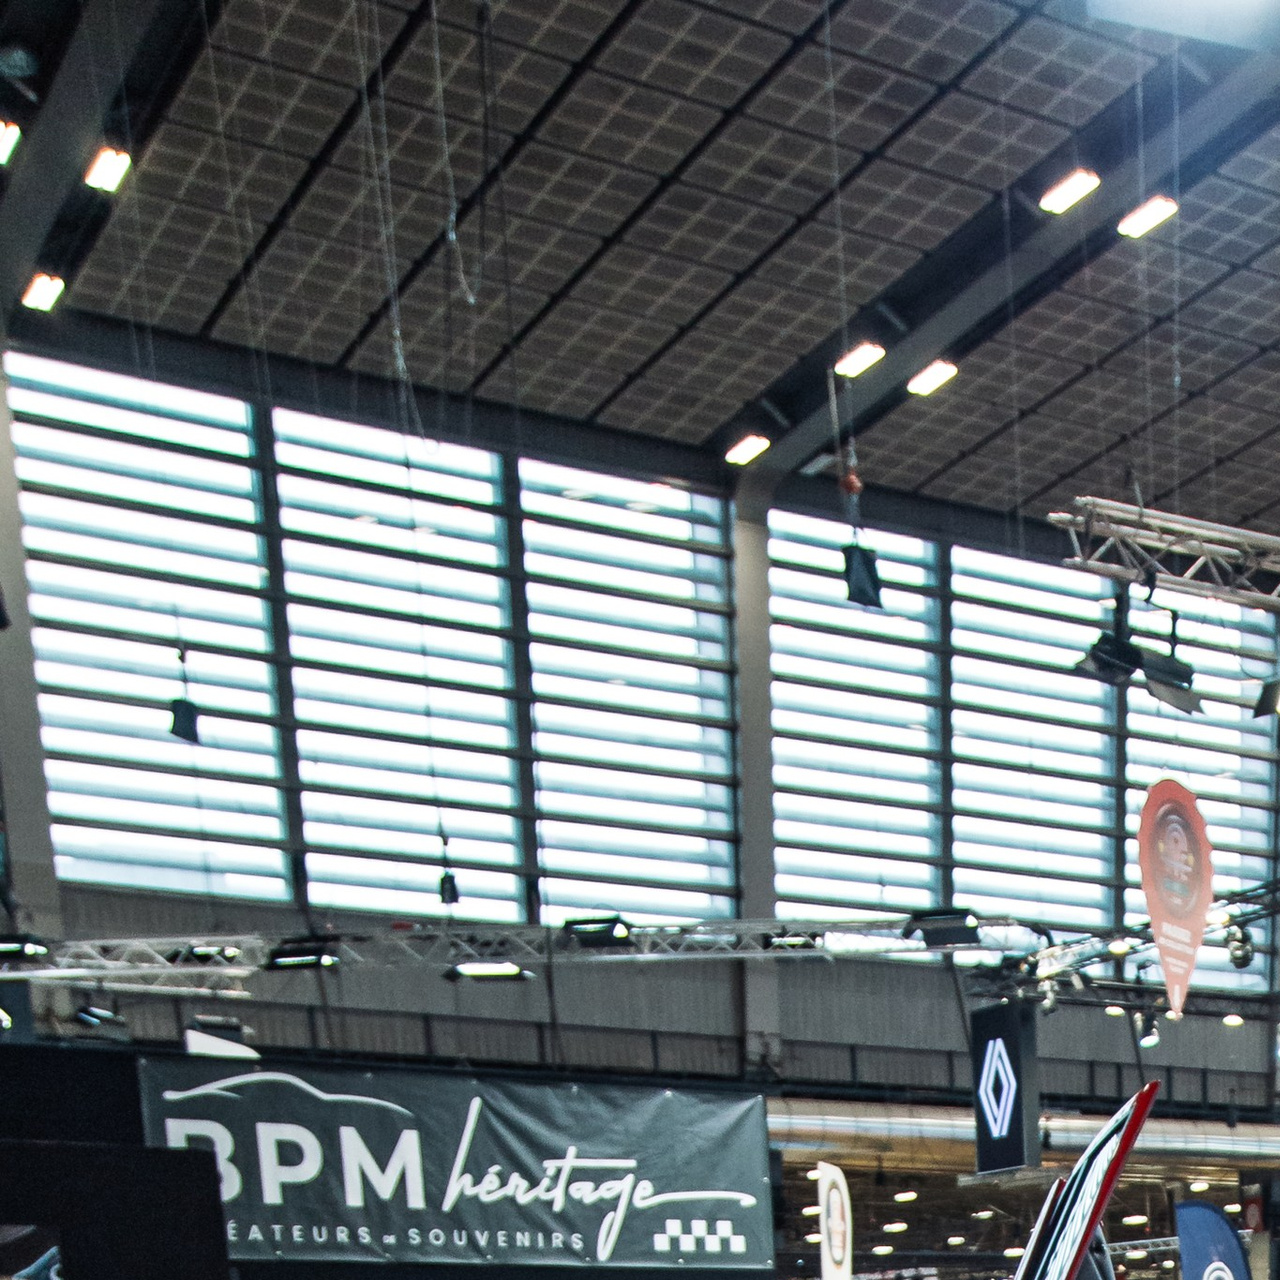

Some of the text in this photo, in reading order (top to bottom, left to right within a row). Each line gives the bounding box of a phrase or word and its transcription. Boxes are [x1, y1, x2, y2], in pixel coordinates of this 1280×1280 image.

[165, 1096, 757, 1262] BPM héritage
[227, 1219, 371, 1243] ÉATEURS
[407, 1228, 585, 1250] SOUVENIRS
